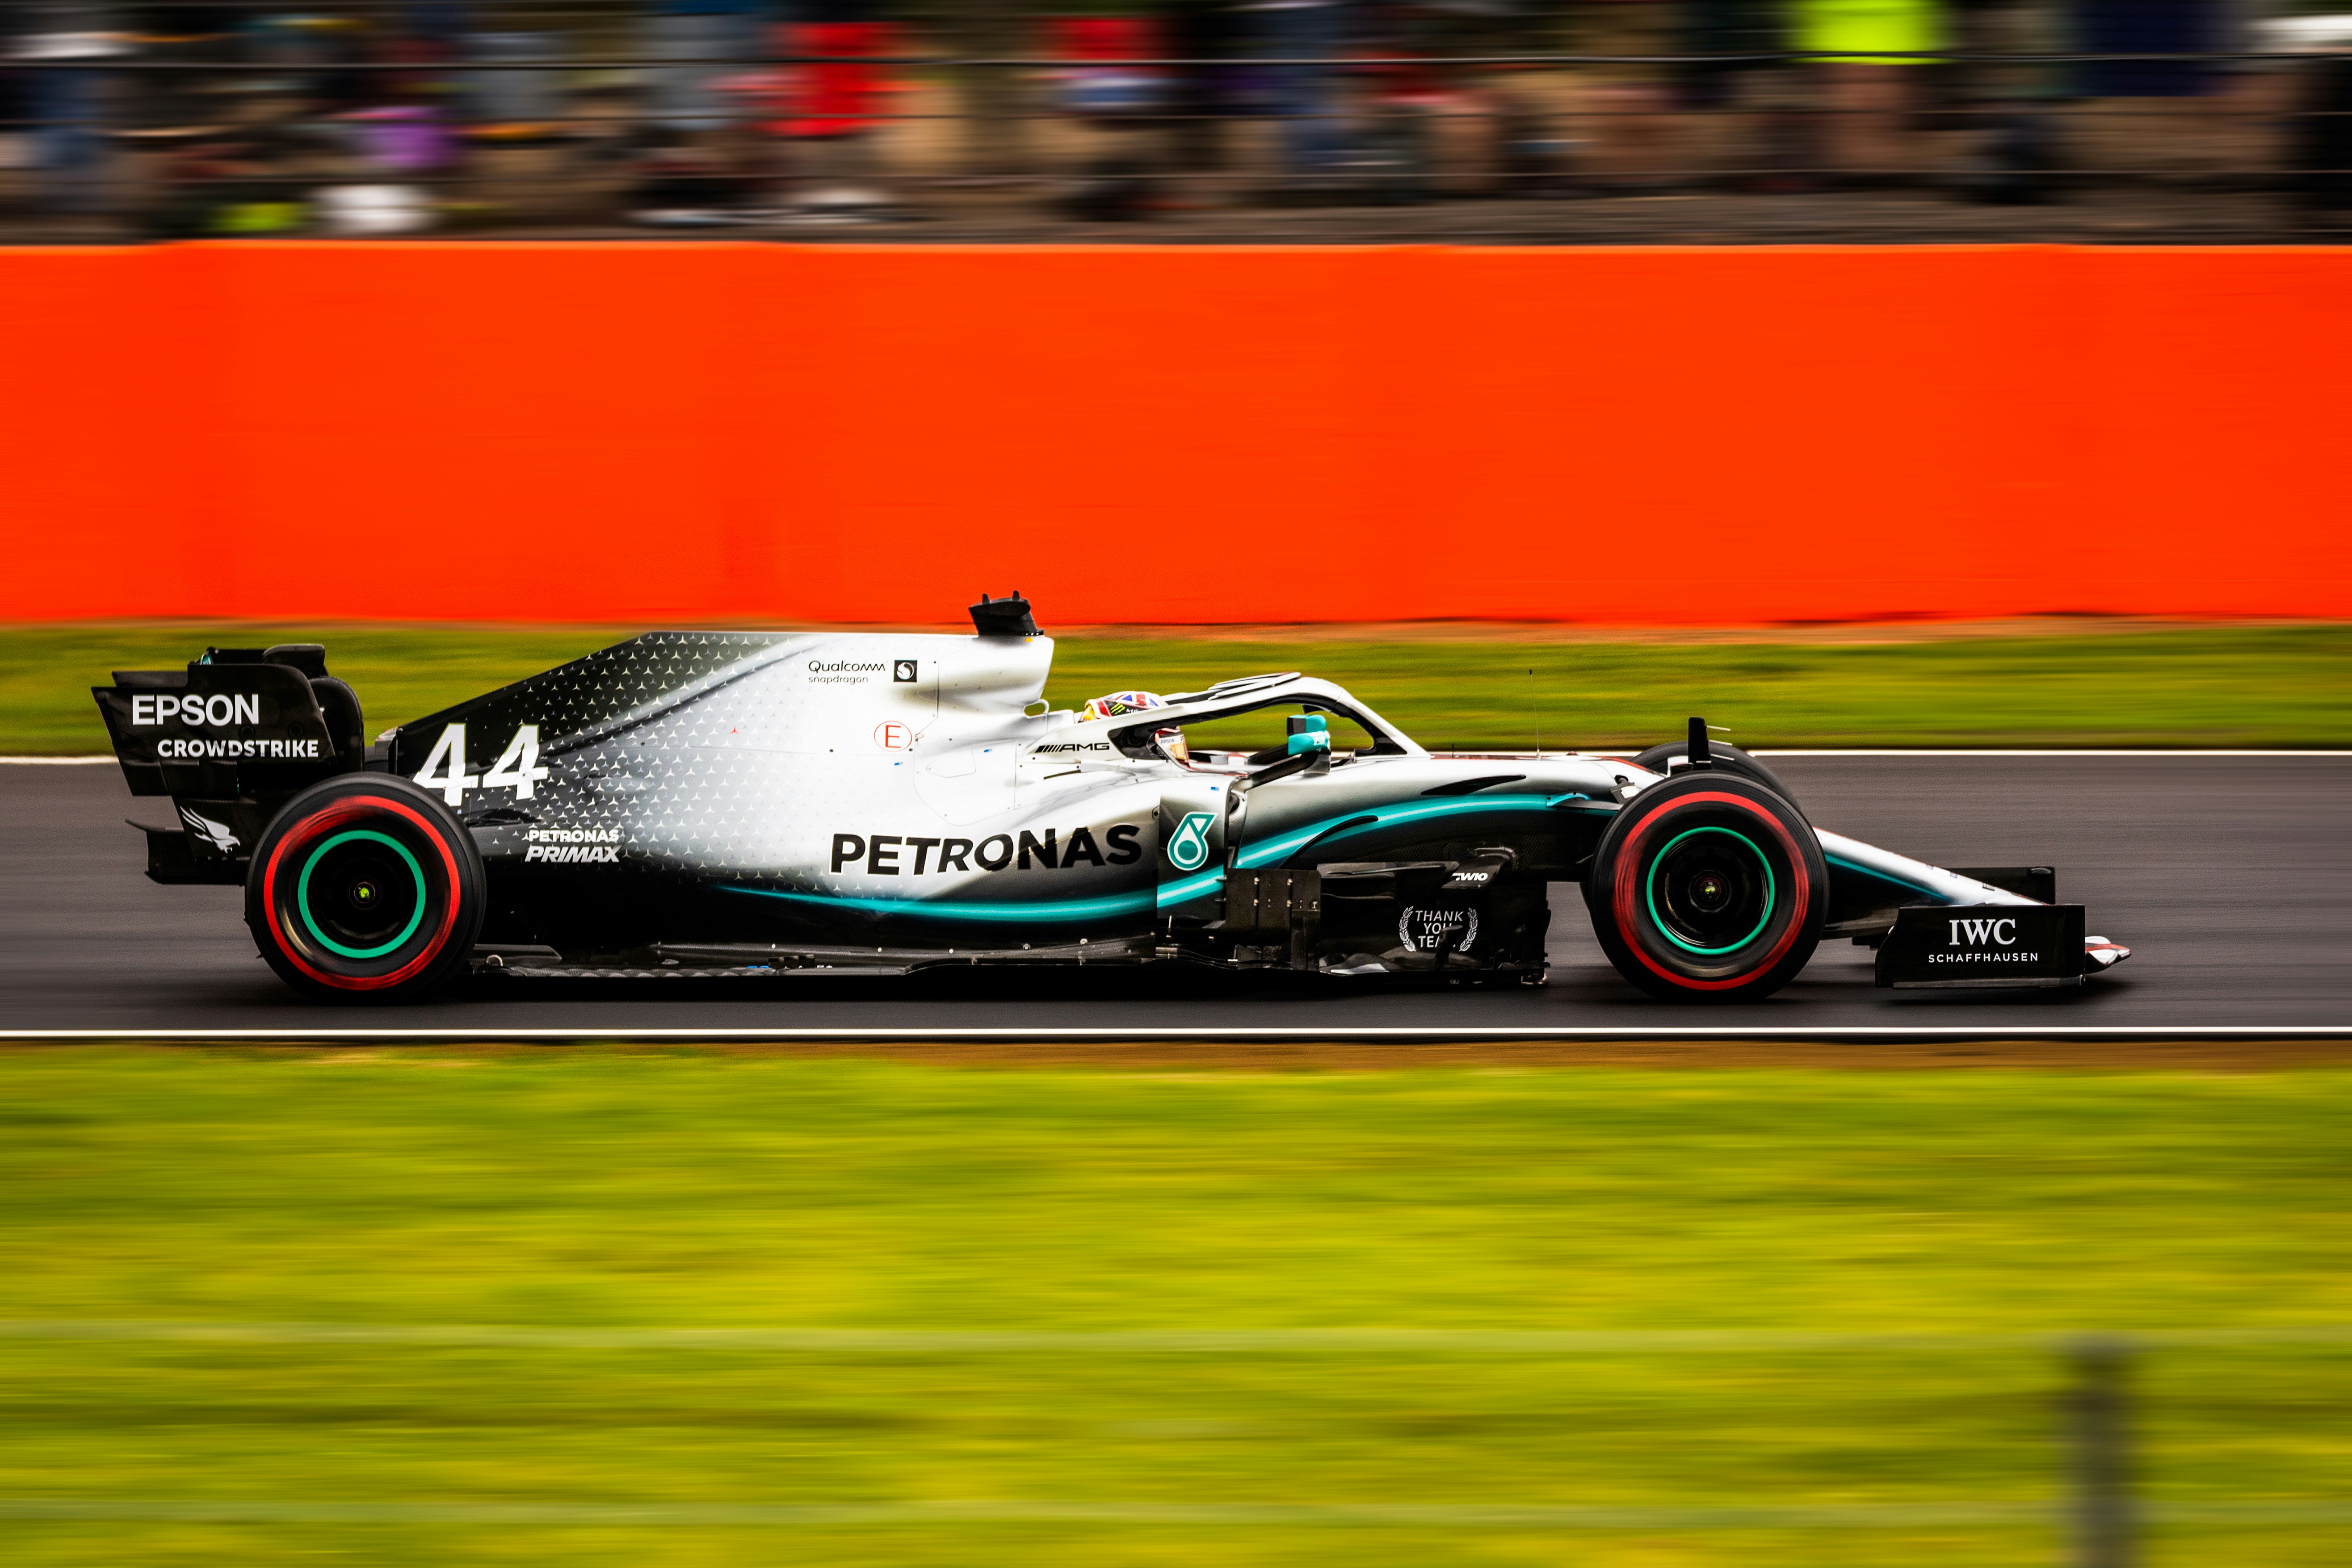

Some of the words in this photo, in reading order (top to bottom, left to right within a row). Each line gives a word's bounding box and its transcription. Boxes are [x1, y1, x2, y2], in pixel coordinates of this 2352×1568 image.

[809, 660, 886, 673] Qualcomm
[809, 675, 868, 685] snapdragon
[132, 694, 259, 727] EPSON
[885, 725, 901, 748] E
[157, 739, 319, 758] CROWDSTRIKE
[1059, 743, 1110, 752] AMG
[412, 723, 549, 807] 44
[529, 829, 620, 843] PETRONAS
[525, 845, 622, 863] PRIMAX
[830, 824, 1142, 876] PETRONAS
[1415, 910, 1464, 922] THANK
[1949, 918, 2016, 945] IWC
[1928, 952, 2038, 963] SCHAFFHAUSEN
